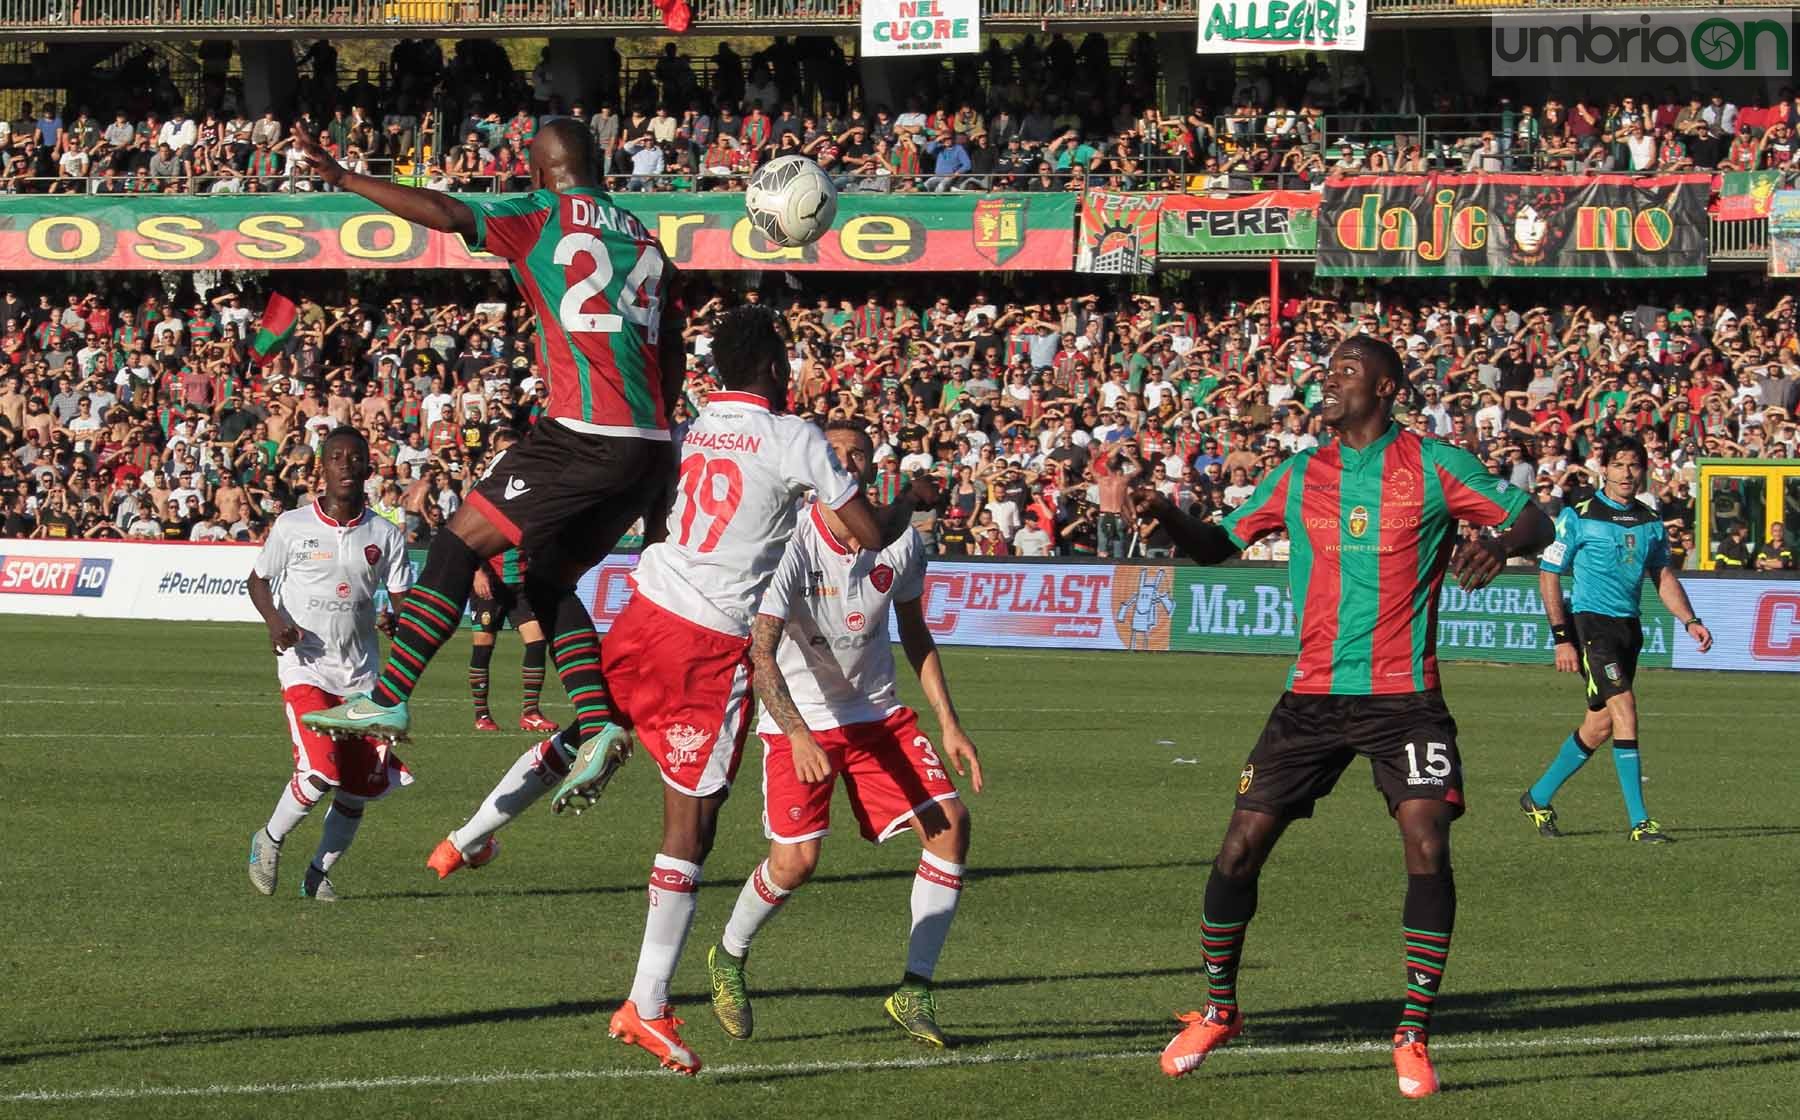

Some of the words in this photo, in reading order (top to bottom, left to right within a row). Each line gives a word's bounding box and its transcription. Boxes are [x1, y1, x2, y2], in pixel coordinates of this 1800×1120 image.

[899, 0, 944, 18] NEL
[873, 18, 969, 41] CUORE
[1089, 191, 1166, 212] TERNI
[1337, 189, 1488, 260] daje
[553, 232, 664, 344] 24
[680, 452, 744, 554] 19
[1305, 517, 1338, 529] 1925
[1381, 516, 1417, 529] 2015
[2, 560, 76, 589] SPORT
[77, 565, 106, 589] HD
[921, 571, 1111, 635] CEPLAST
[1503, 622, 1538, 649] LE
[913, 736, 940, 766] 3
[1405, 742, 1451, 777] 15
